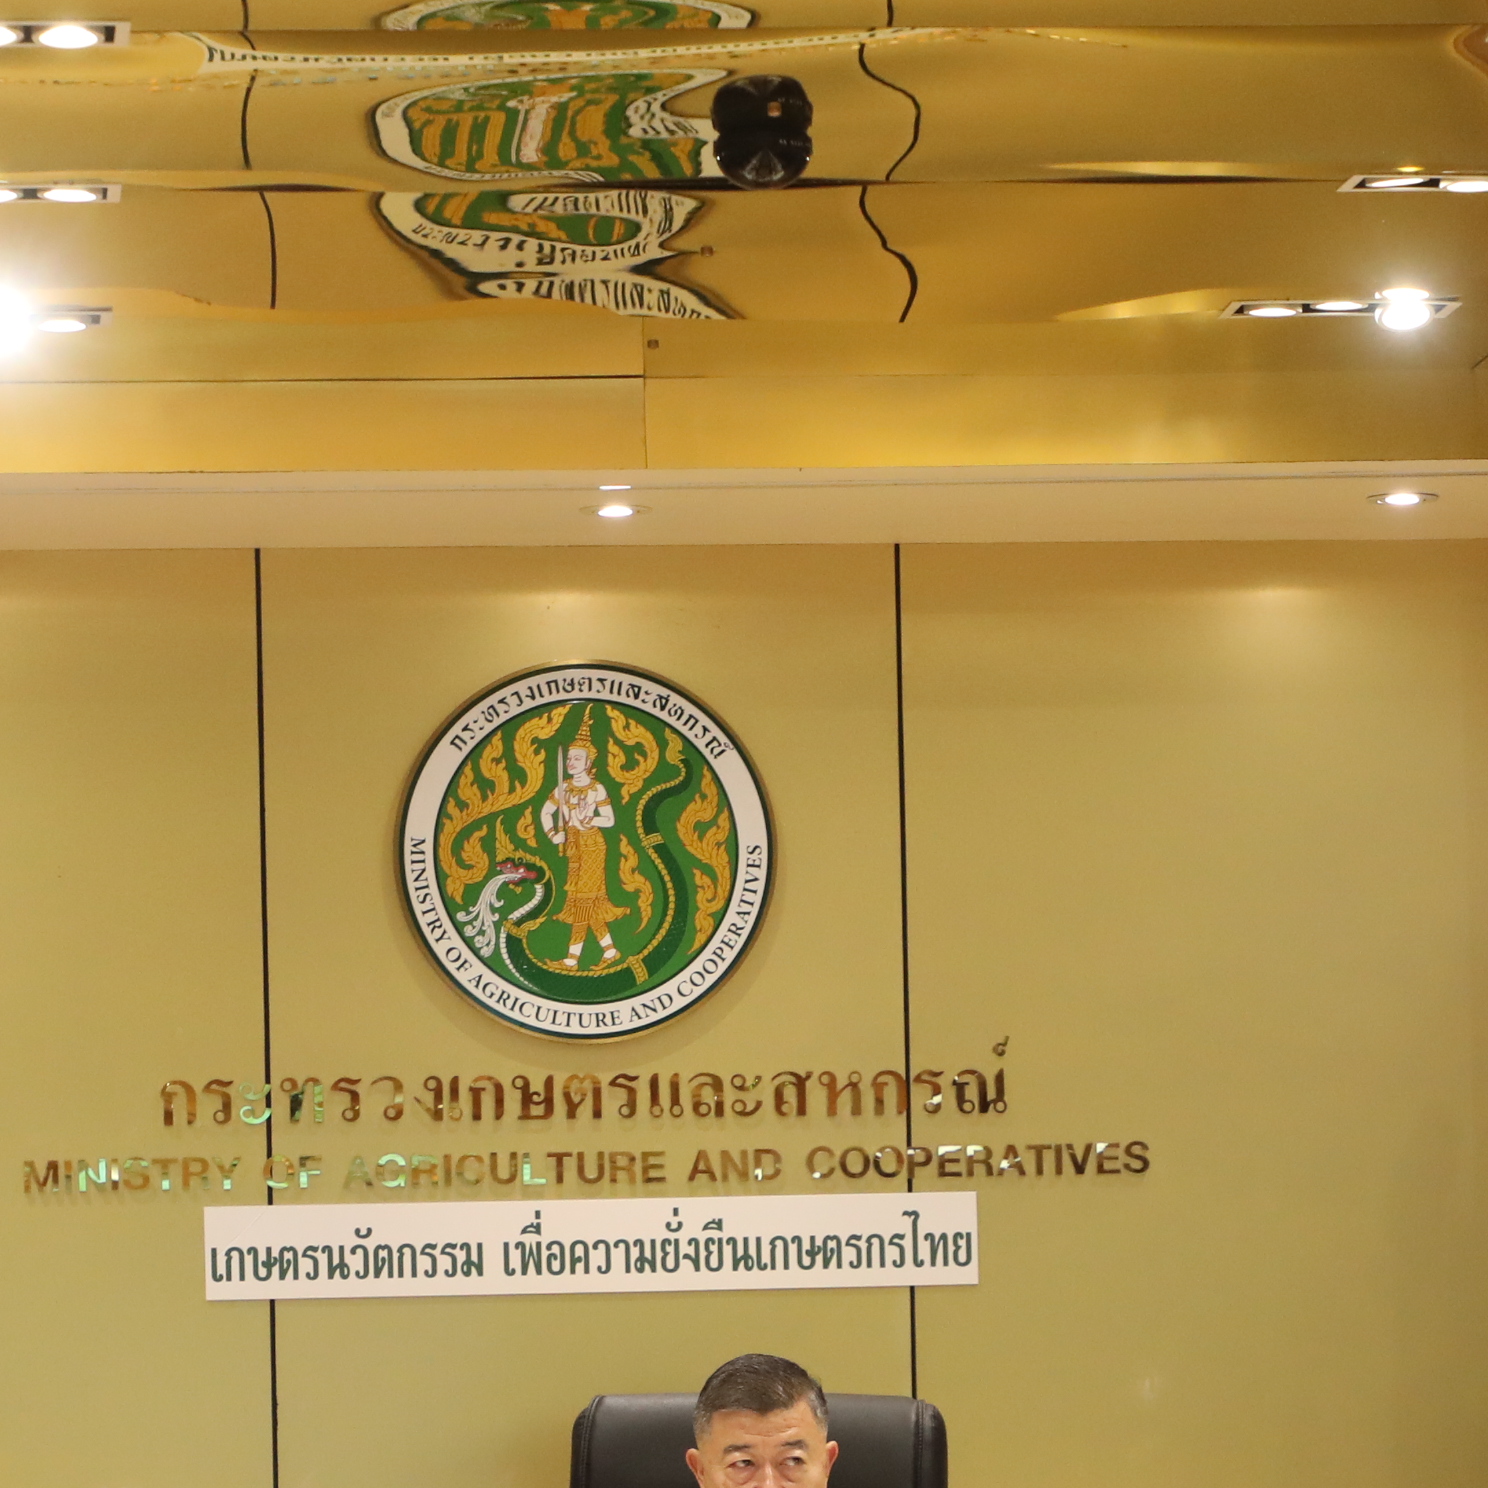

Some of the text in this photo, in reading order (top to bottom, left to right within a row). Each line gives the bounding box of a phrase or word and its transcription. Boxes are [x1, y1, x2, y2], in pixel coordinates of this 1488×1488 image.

[449, 675, 735, 761] กระทรวงเกษตรและสหกรณ์
[409, 837, 764, 1030] MINISTRY OF AGRICULTURE AND COOPERATIVES
[159, 1035, 1009, 1127] กระทรวงเกษตรและสหกรณ์
[22, 1140, 1151, 1194] MINISTRY OF AGRICULTURE AND COOPERATIVES
[210, 1206, 974, 1283] เกษตรนวัตกรรม เพื่อความยั่งยืนเกษตรกรไทย
